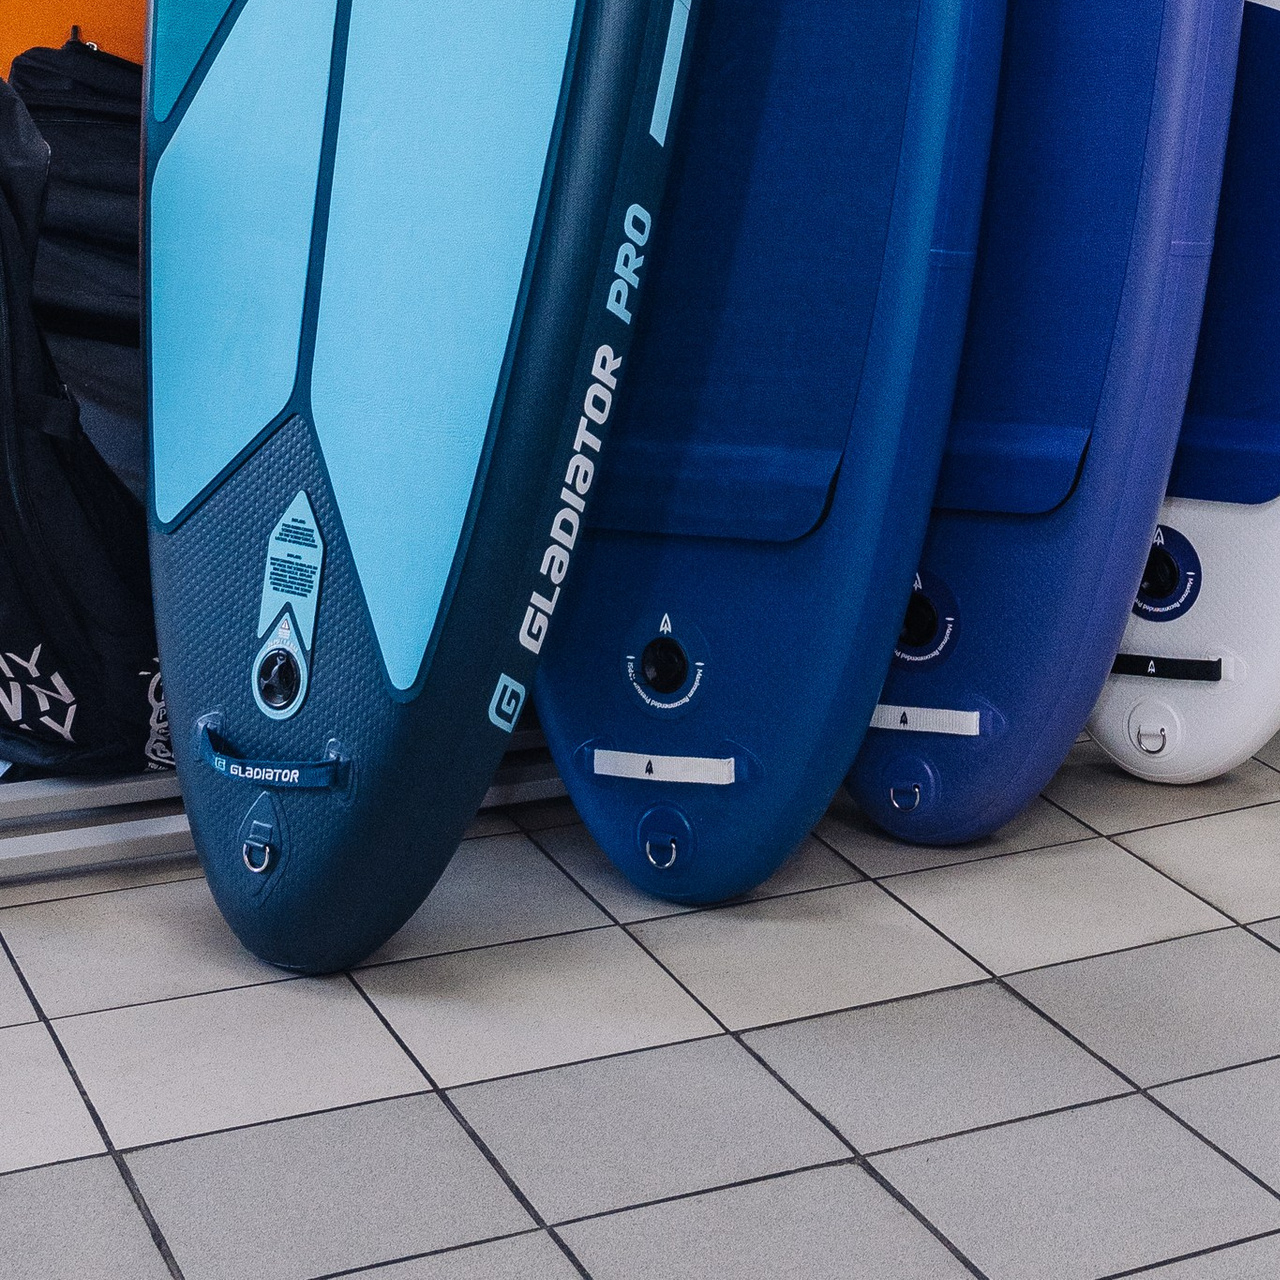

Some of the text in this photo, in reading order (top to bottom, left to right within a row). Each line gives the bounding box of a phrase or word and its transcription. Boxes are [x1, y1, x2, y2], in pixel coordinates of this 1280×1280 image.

[518, 343, 623, 654] GLADIATOR
[606, 203, 651, 325] PRO
[229, 764, 300, 783] GLADIATOR
